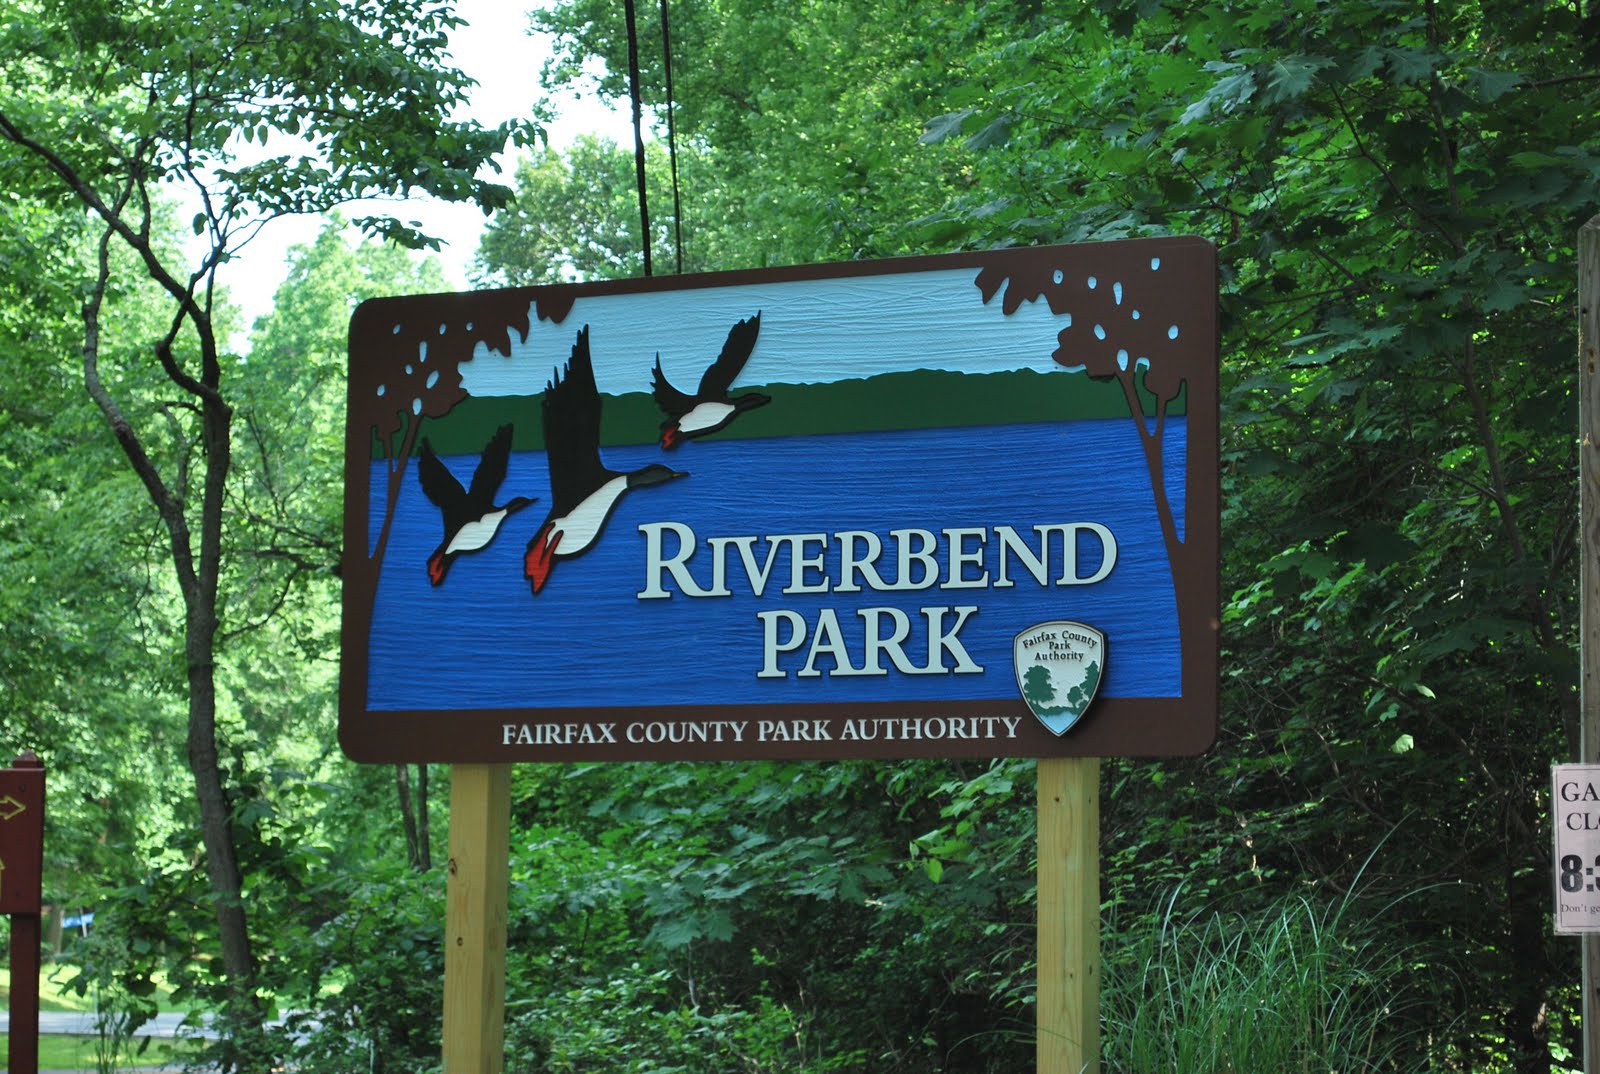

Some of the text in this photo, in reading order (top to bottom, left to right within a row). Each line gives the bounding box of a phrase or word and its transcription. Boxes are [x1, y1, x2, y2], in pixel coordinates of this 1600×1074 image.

[637, 521, 1119, 600] RIVERBEND
[756, 605, 984, 679] PARK
[1022, 630, 1098, 649] Fairfax County
[1048, 640, 1071, 650] Park
[1034, 650, 1084, 662] Authority
[501, 716, 1022, 745] FAIRFAX COUNTY PARK AUTHORITY
[1561, 903, 1587, 913] Don't
